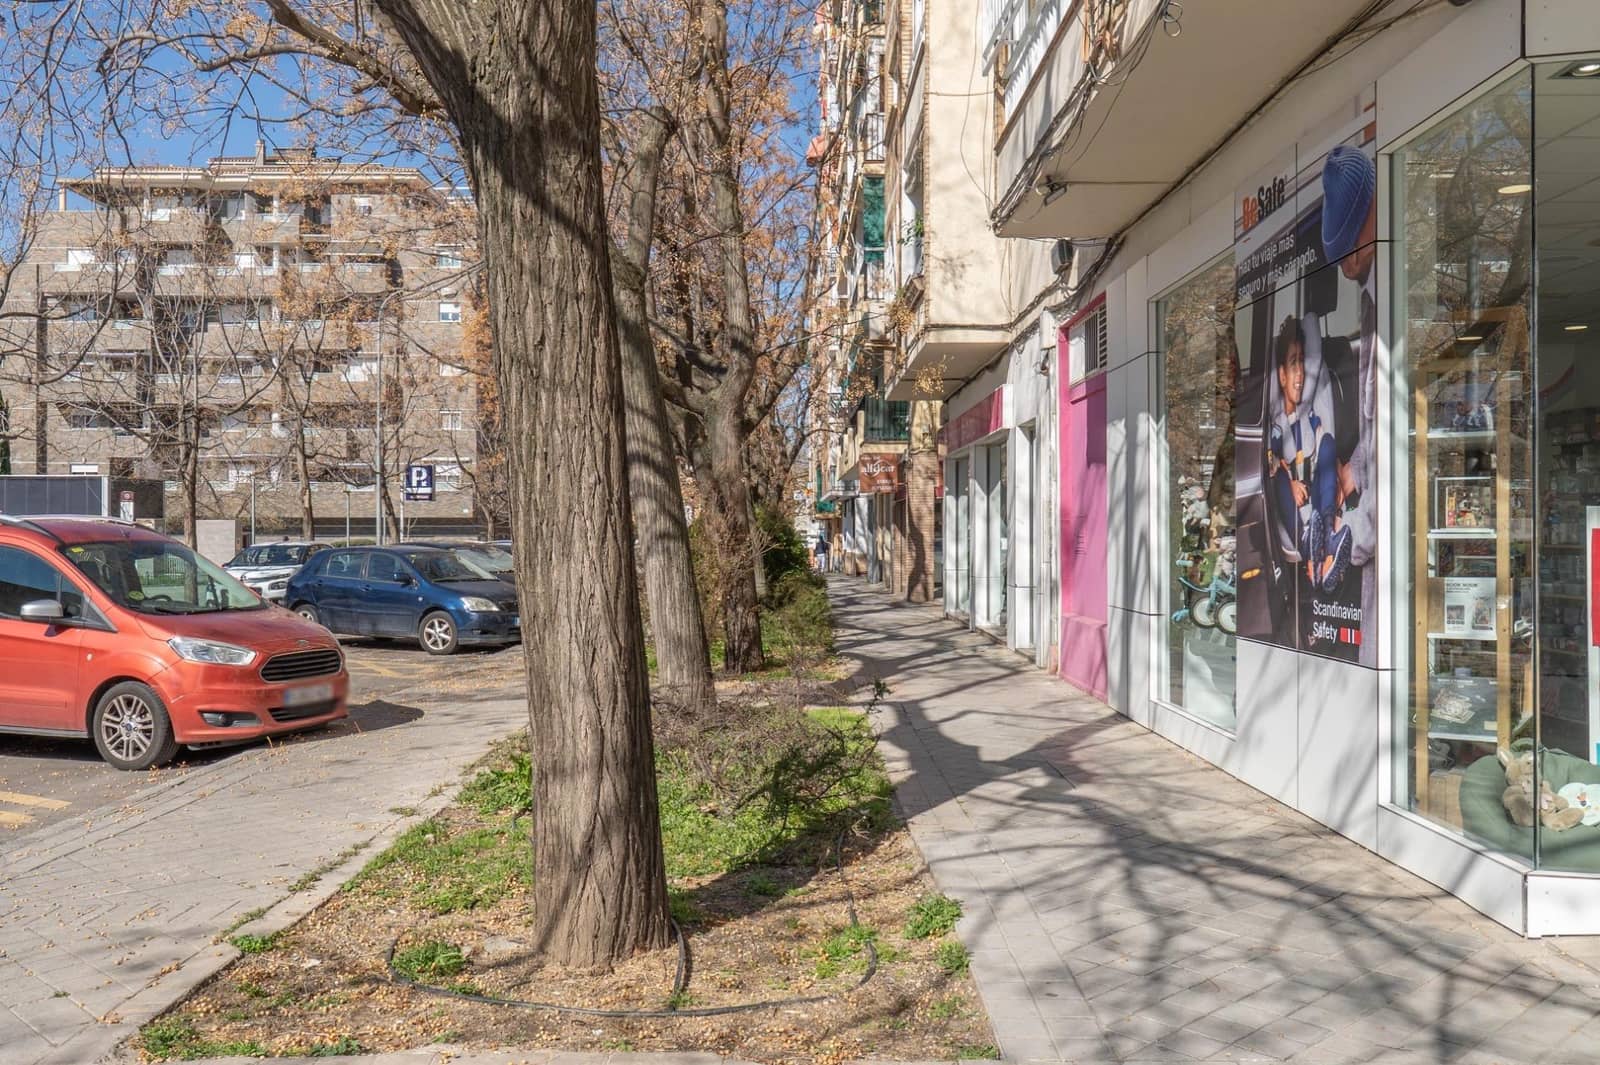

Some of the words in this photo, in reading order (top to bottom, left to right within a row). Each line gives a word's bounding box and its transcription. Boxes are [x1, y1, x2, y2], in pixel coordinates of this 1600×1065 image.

[1252, 254, 1260, 269] tu
[1260, 242, 1278, 264] viaje
[1279, 231, 1295, 254] más
[1238, 277, 1261, 298] seguro
[411, 466, 428, 487] P
[1312, 599, 1363, 621] Scandinavian
[1312, 620, 1338, 644] Safety
